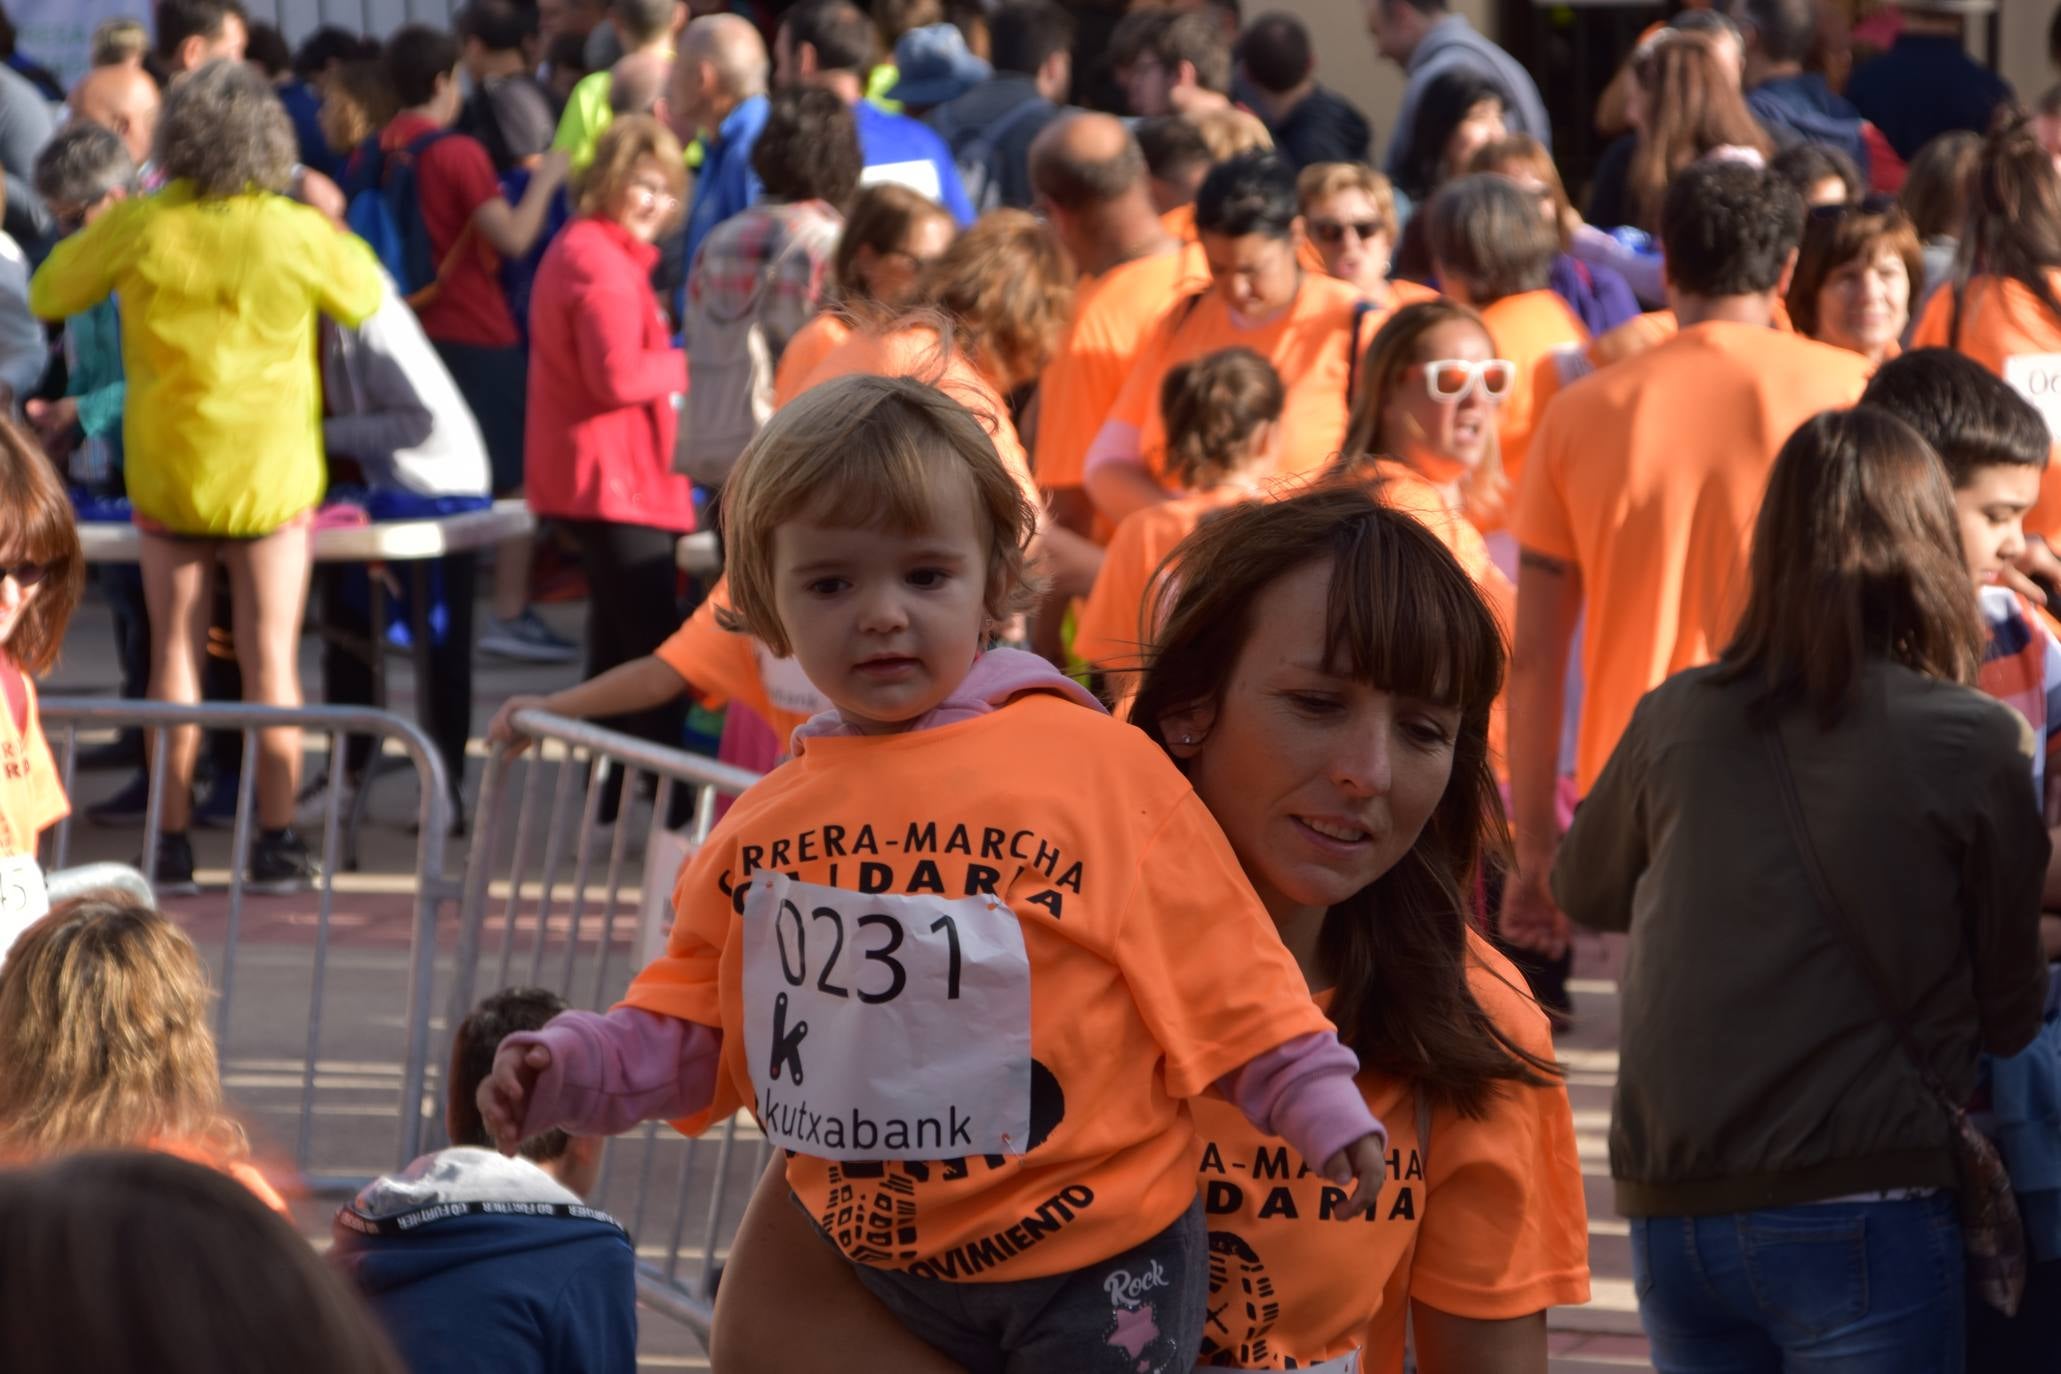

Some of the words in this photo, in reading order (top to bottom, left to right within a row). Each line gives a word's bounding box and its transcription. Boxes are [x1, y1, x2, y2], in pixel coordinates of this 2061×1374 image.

[718, 821, 1083, 897] CRRERA-MARCHA
[776, 899, 962, 1004] 0231
[769, 991, 808, 1086] k
[765, 1088, 972, 1150] kutxabank
[907, 1185, 1094, 1279] OVIMIENTO
[1103, 1258, 1170, 1305] Rock
